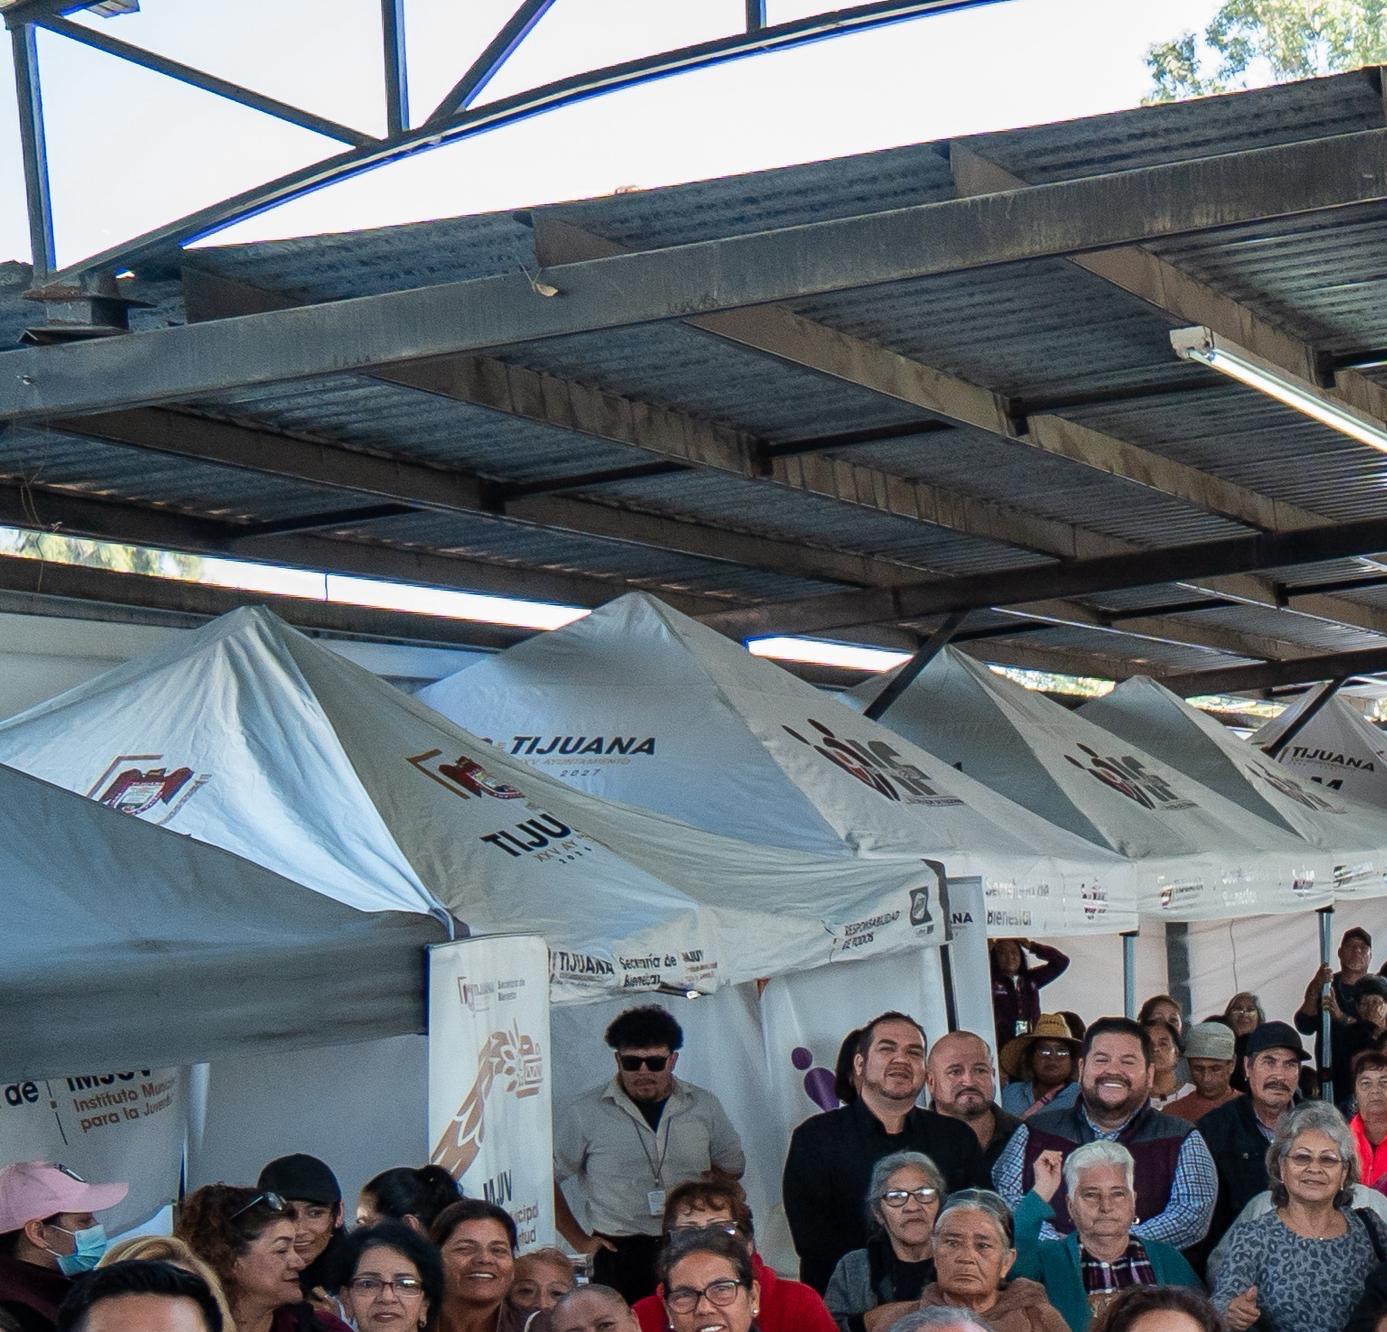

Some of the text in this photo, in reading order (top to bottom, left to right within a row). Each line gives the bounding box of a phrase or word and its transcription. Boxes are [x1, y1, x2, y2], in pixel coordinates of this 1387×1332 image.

[511, 736, 656, 756] TIJUANA
[1293, 746, 1375, 772] TIJUANA
[558, 951, 615, 975] TIJUANA
[73, 1089, 138, 1113] Instituto
[80, 1111, 120, 1133] para
[123, 1106, 139, 1121] la
